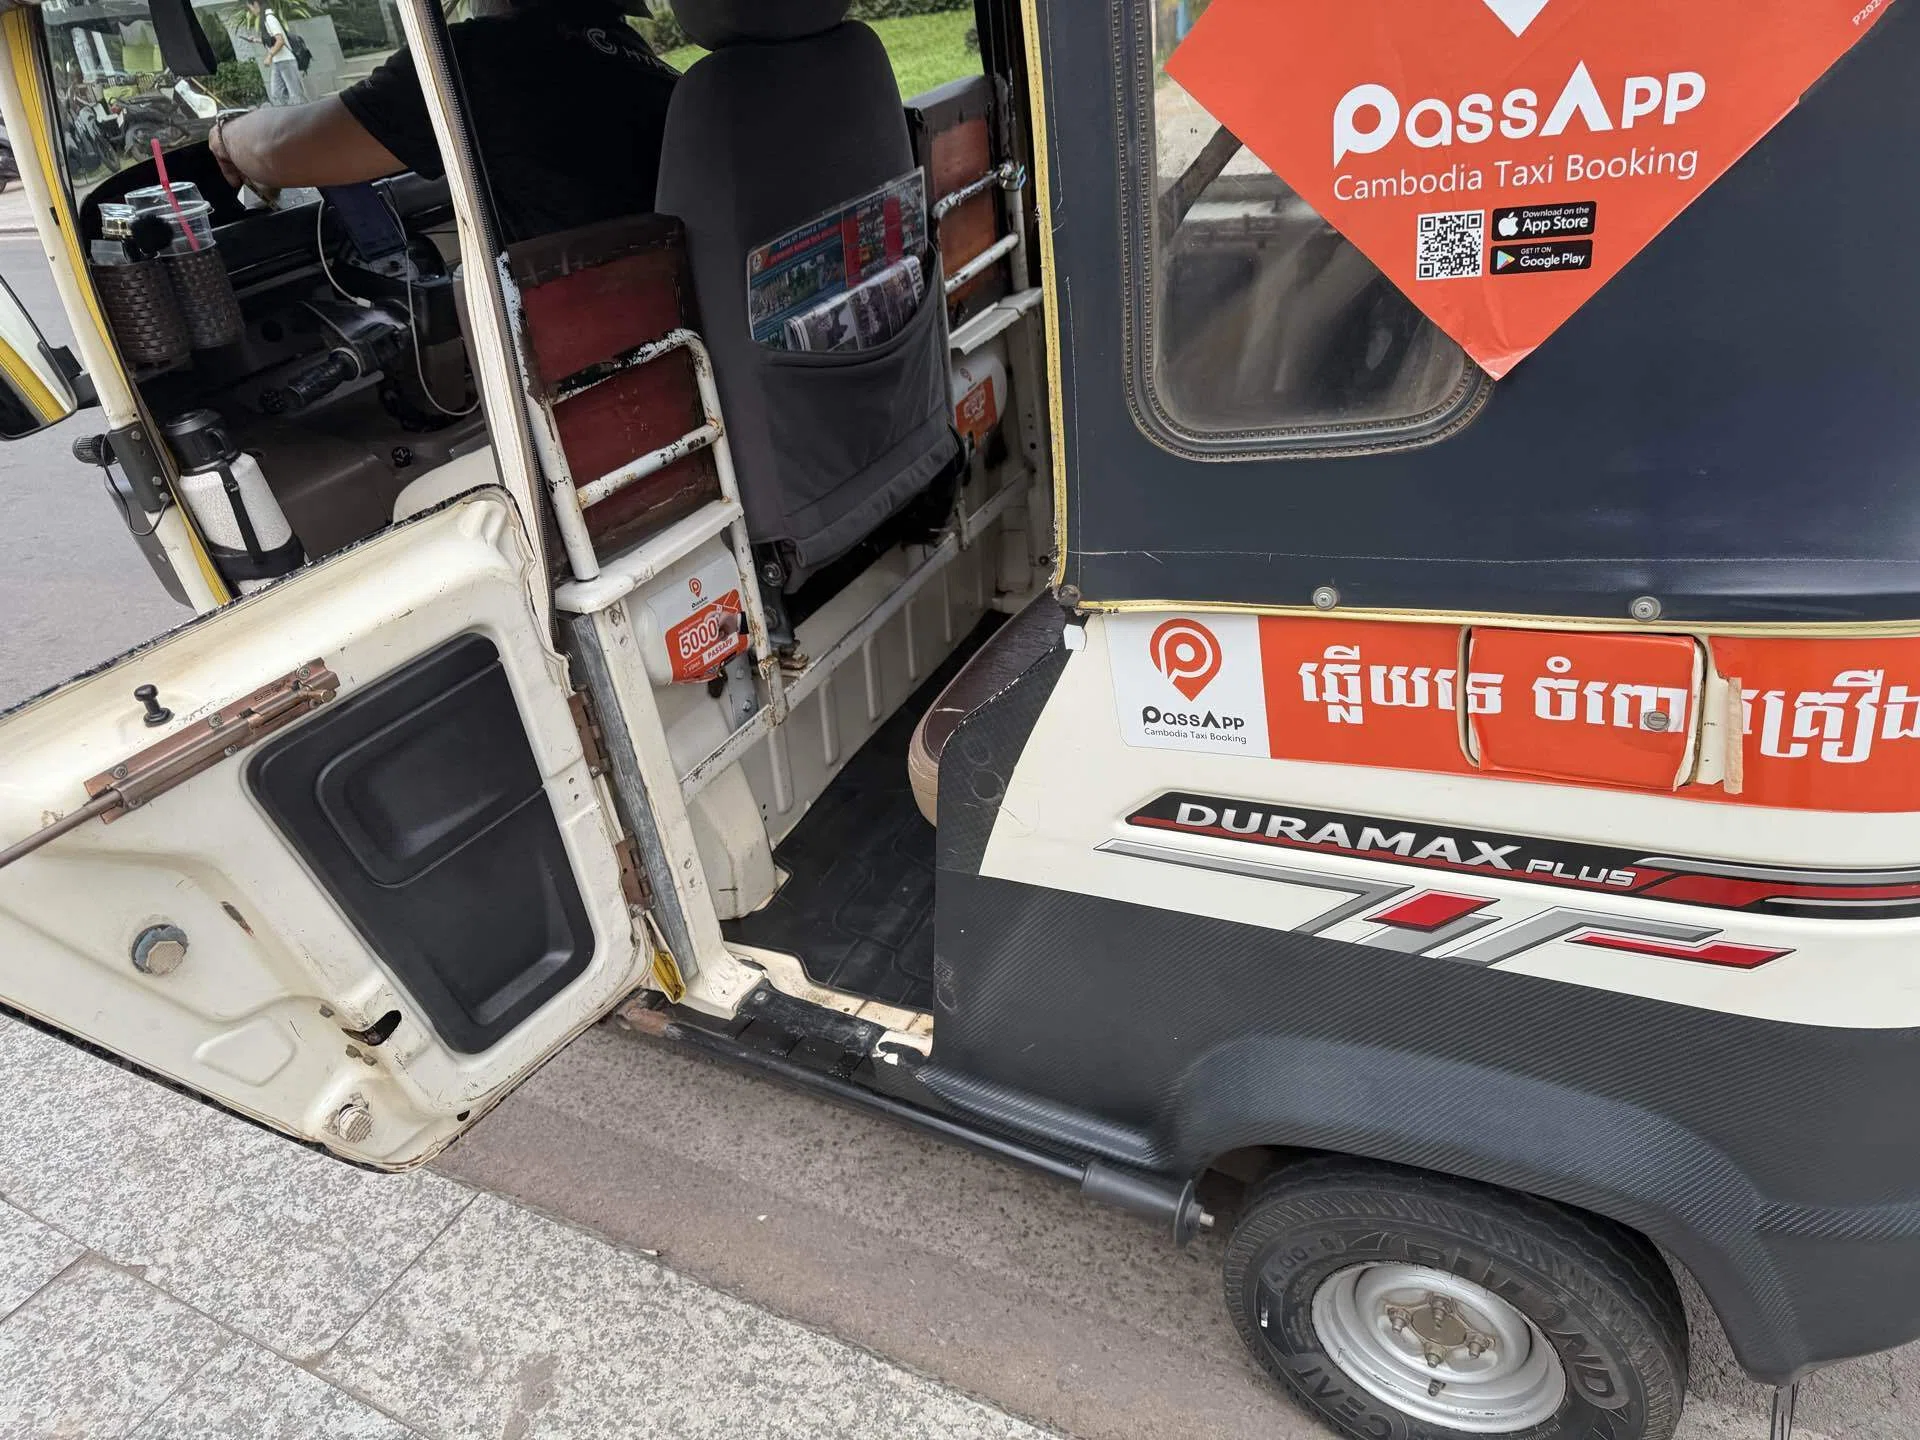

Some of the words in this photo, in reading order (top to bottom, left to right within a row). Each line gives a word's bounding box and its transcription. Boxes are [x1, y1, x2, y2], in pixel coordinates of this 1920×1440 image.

[1333, 163, 1483, 201] Cambodia
[1494, 155, 1554, 188] Taxi
[1566, 145, 1699, 181] Booking
[1522, 209, 1563, 218] Download
[1564, 208, 1575, 216] on
[1575, 206, 1590, 215] the
[1522, 219, 1551, 234] App
[1553, 216, 1589, 230] Store
[1520, 247, 1534, 255] GET
[1520, 254, 1560, 269] Google
[1562, 253, 1585, 266] Play
[1144, 727, 1188, 738] Cambodia
[1190, 730, 1207, 740] Taxi
[1210, 733, 1247, 744] Booking
[1175, 802, 1521, 871] DURAMAX
[1525, 858, 1637, 888] PLUS
